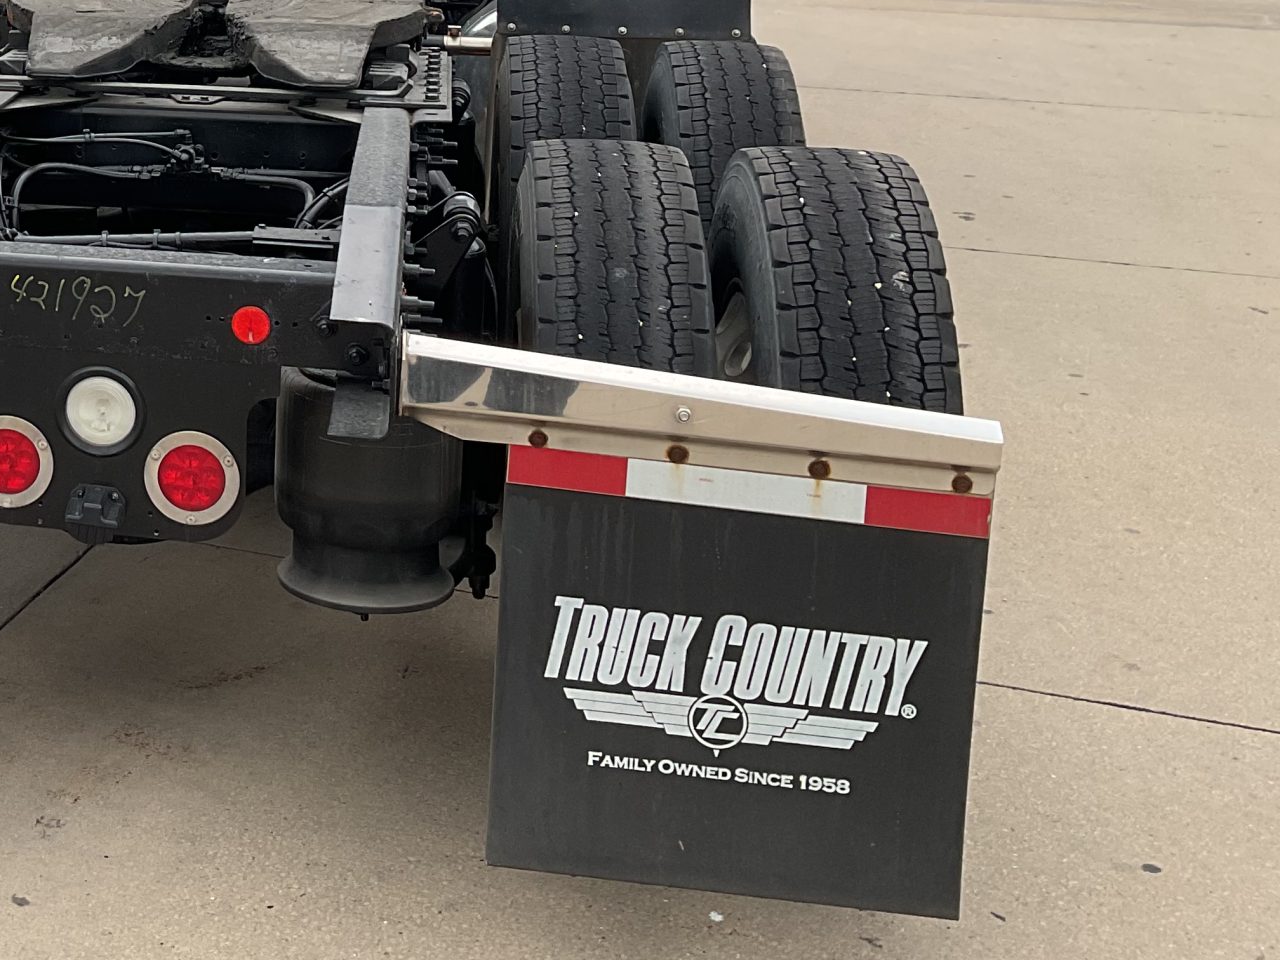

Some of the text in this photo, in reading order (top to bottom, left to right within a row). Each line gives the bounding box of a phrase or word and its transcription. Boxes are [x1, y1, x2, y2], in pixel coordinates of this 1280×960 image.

[10, 274, 146, 327] 421927
[543, 595, 702, 692] TRUCK
[587, 750, 851, 795] FAMILY OWNED SINCE 1958
